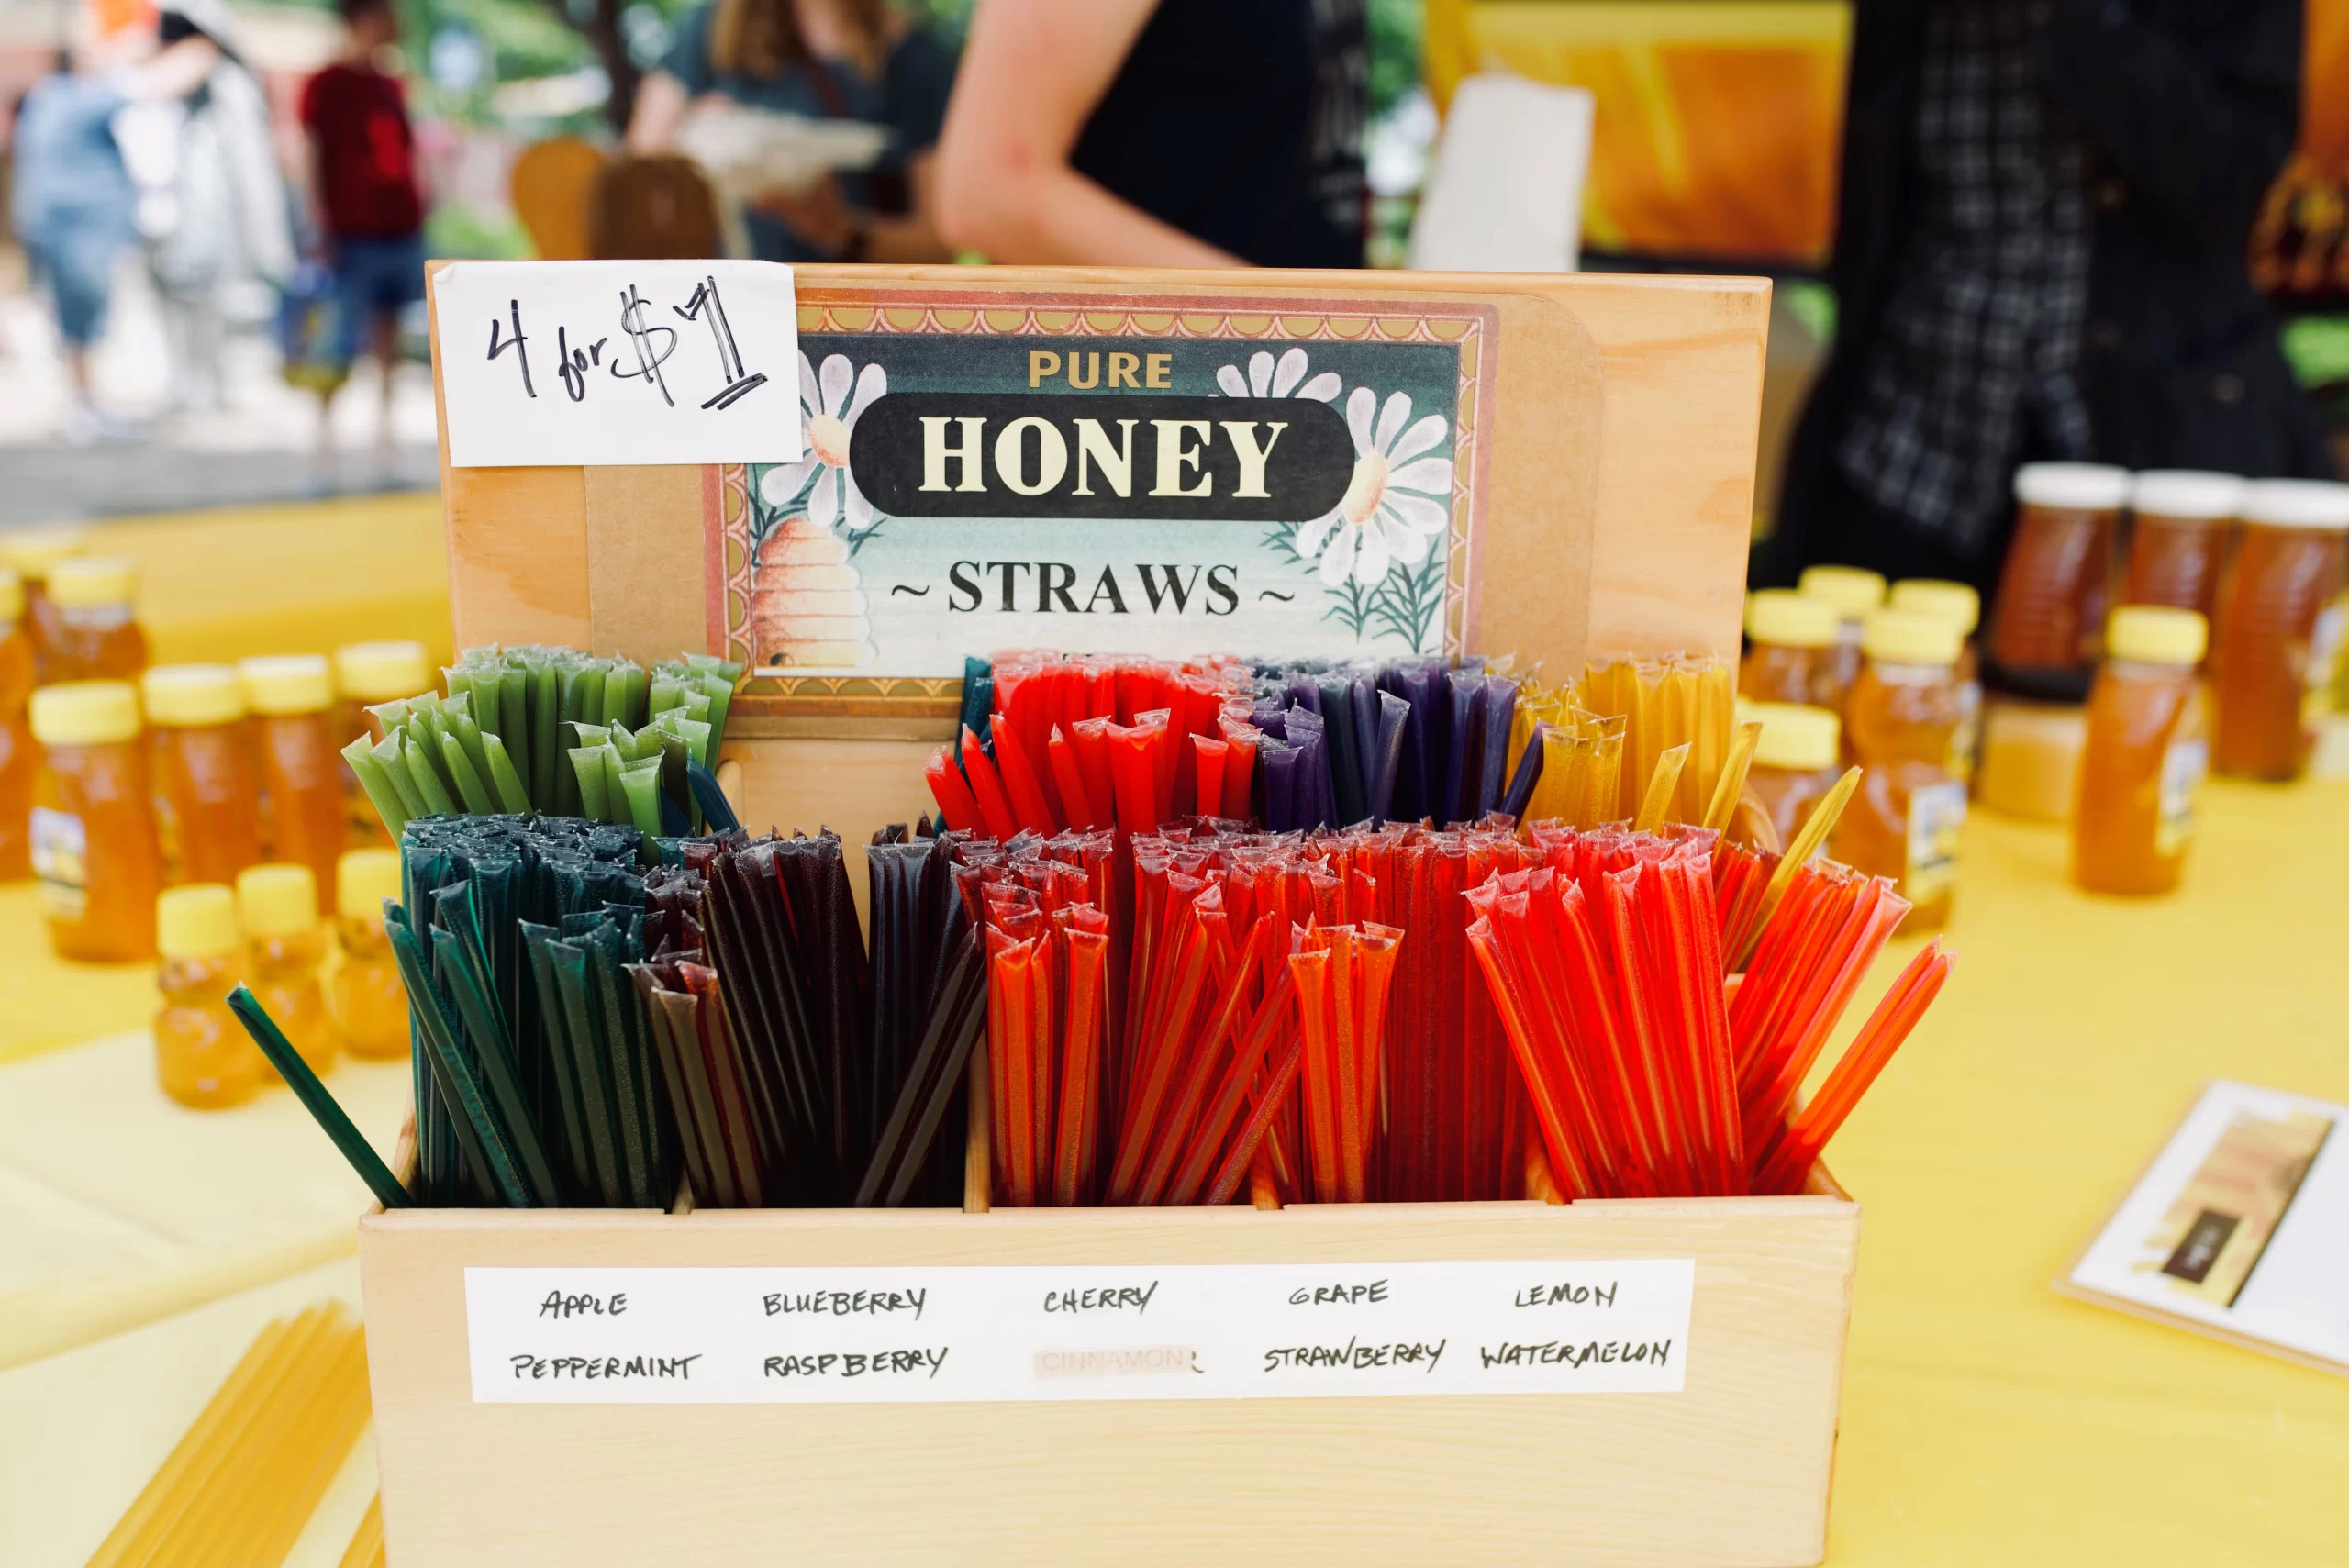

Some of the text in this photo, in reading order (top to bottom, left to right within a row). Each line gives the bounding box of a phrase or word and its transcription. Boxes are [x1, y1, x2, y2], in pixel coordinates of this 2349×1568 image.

[486, 299, 538, 398] 4
[558, 326, 607, 402] for
[1029, 350, 1174, 389] PURE
[918, 416, 1289, 498] HONEY
[948, 561, 1240, 616] STRAWS
[540, 1290, 629, 1319] APPLE
[763, 1288, 927, 1320] BLUEBERRY
[1043, 1281, 1159, 1313] CHERRY
[1289, 1280, 1390, 1306] GRAPE
[1515, 1281, 1618, 1308] LEMON
[510, 1353, 702, 1381] PEPPERMINT
[763, 1347, 949, 1379] RASPBERRY
[1041, 1349, 1184, 1372] CINNAMON
[1264, 1336, 1447, 1372] STRAWBERRY
[1480, 1339, 1672, 1370] WATERMELON
